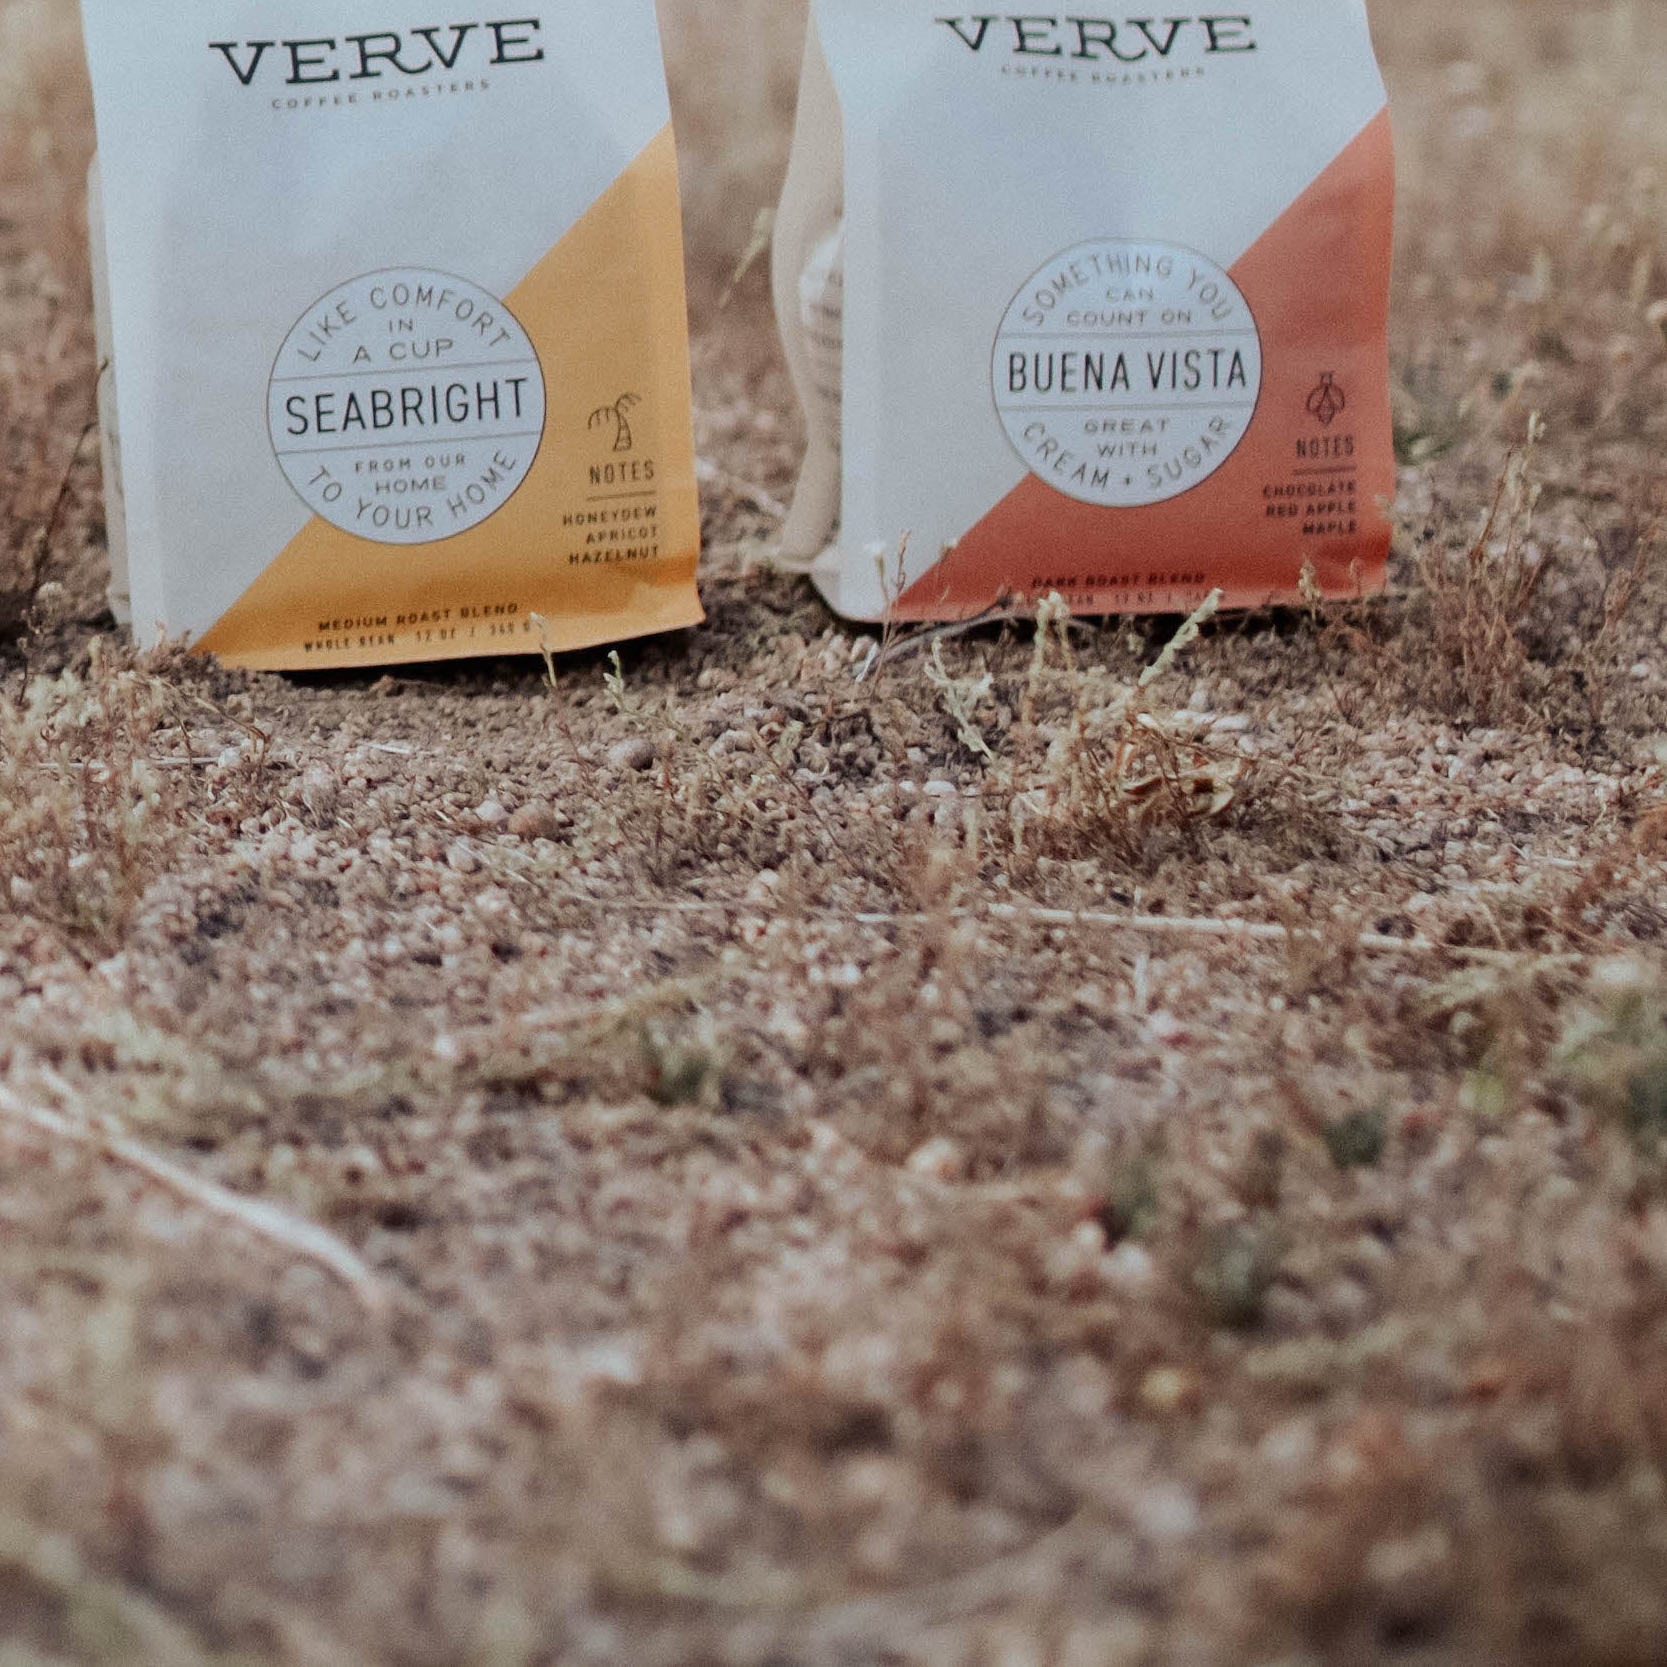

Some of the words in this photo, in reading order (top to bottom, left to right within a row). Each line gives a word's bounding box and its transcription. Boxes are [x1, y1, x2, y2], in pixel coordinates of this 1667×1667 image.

[934, 15, 1257, 61] VERVE
[208, 17, 544, 85] VERVE
[273, 93, 357, 109] COFFEE
[373, 79, 490, 101] ROASTERS
[1023, 254, 1173, 326] SOMETHING
[1188, 267, 1232, 321] YOU
[1106, 288, 1154, 302] CAN
[297, 301, 357, 363] LIKE
[370, 283, 511, 348] COMFORT
[389, 318, 413, 332] IN
[1067, 310, 1147, 325] COUNT
[1161, 310, 1191, 324] ON
[353, 345, 371, 364] A
[389, 338, 453, 360] CUP
[1008, 351, 1129, 393] BUENA
[1147, 348, 1246, 389] VISTA
[286, 377, 527, 435] SEABRIGHT
[1084, 418, 1169, 434] GREAT
[1024, 422, 1109, 489] CREAM
[1147, 417, 1229, 487] SUGAR
[1097, 442, 1157, 458] WITH
[1296, 435, 1354, 457] NOTES
[355, 460, 411, 474] FROM
[425, 454, 466, 468] OUR
[590, 460, 654, 485] NOTES
[308, 465, 343, 502] TO
[357, 498, 434, 529] YOUR
[447, 450, 517, 517] HOME
[375, 476, 446, 494] HOME
[563, 505, 657, 526] HONEYDEW
[586, 526, 658, 544] APRICOT
[570, 545, 658, 564] HAZELNUT
[319, 616, 387, 631] MEDIUM
